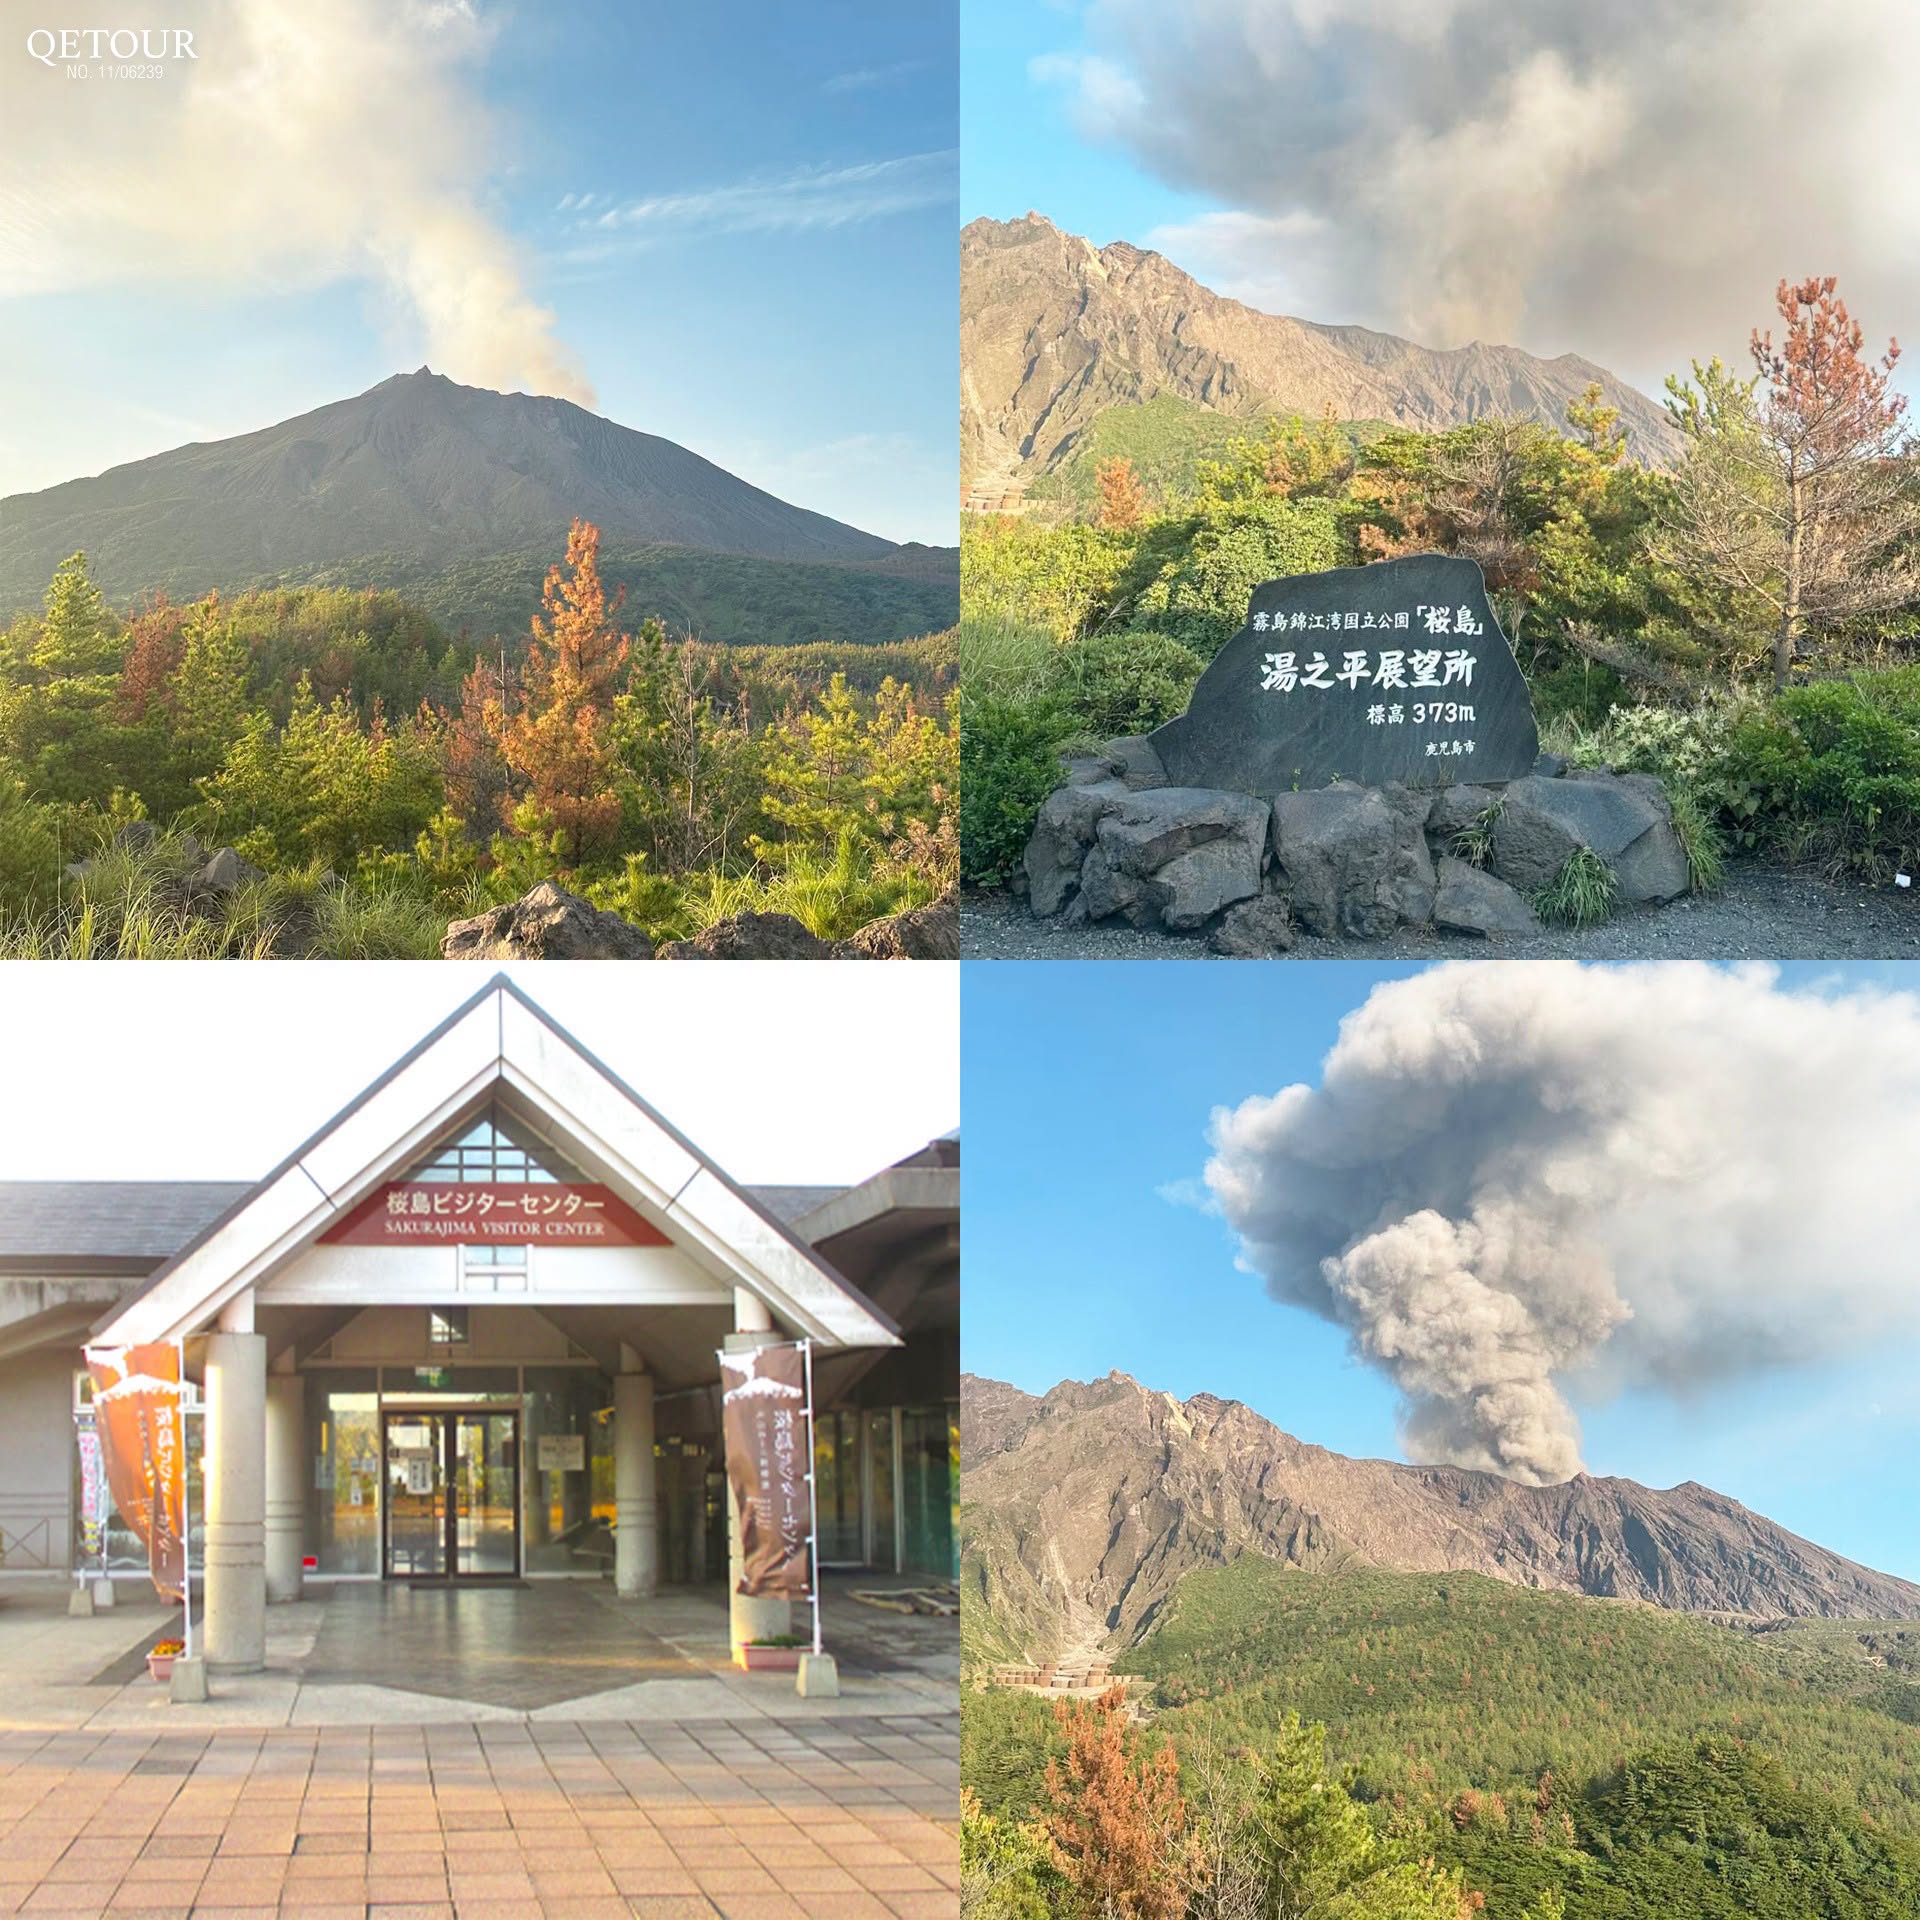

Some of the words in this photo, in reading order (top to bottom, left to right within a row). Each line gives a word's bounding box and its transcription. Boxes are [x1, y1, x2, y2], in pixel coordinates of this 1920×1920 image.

[1259, 649, 1478, 692] 湯之平展望所
[1366, 704, 1404, 725] 標高
[1412, 702, 1476, 723] 373m
[1425, 740, 1476, 757] 鹿児島市
[386, 1192, 605, 1216] 桜島ビジターセンター
[384, 1221, 476, 1237] SAKURAJIMA
[482, 1221, 541, 1236] VISITOR
[545, 1221, 605, 1236] CENTER
